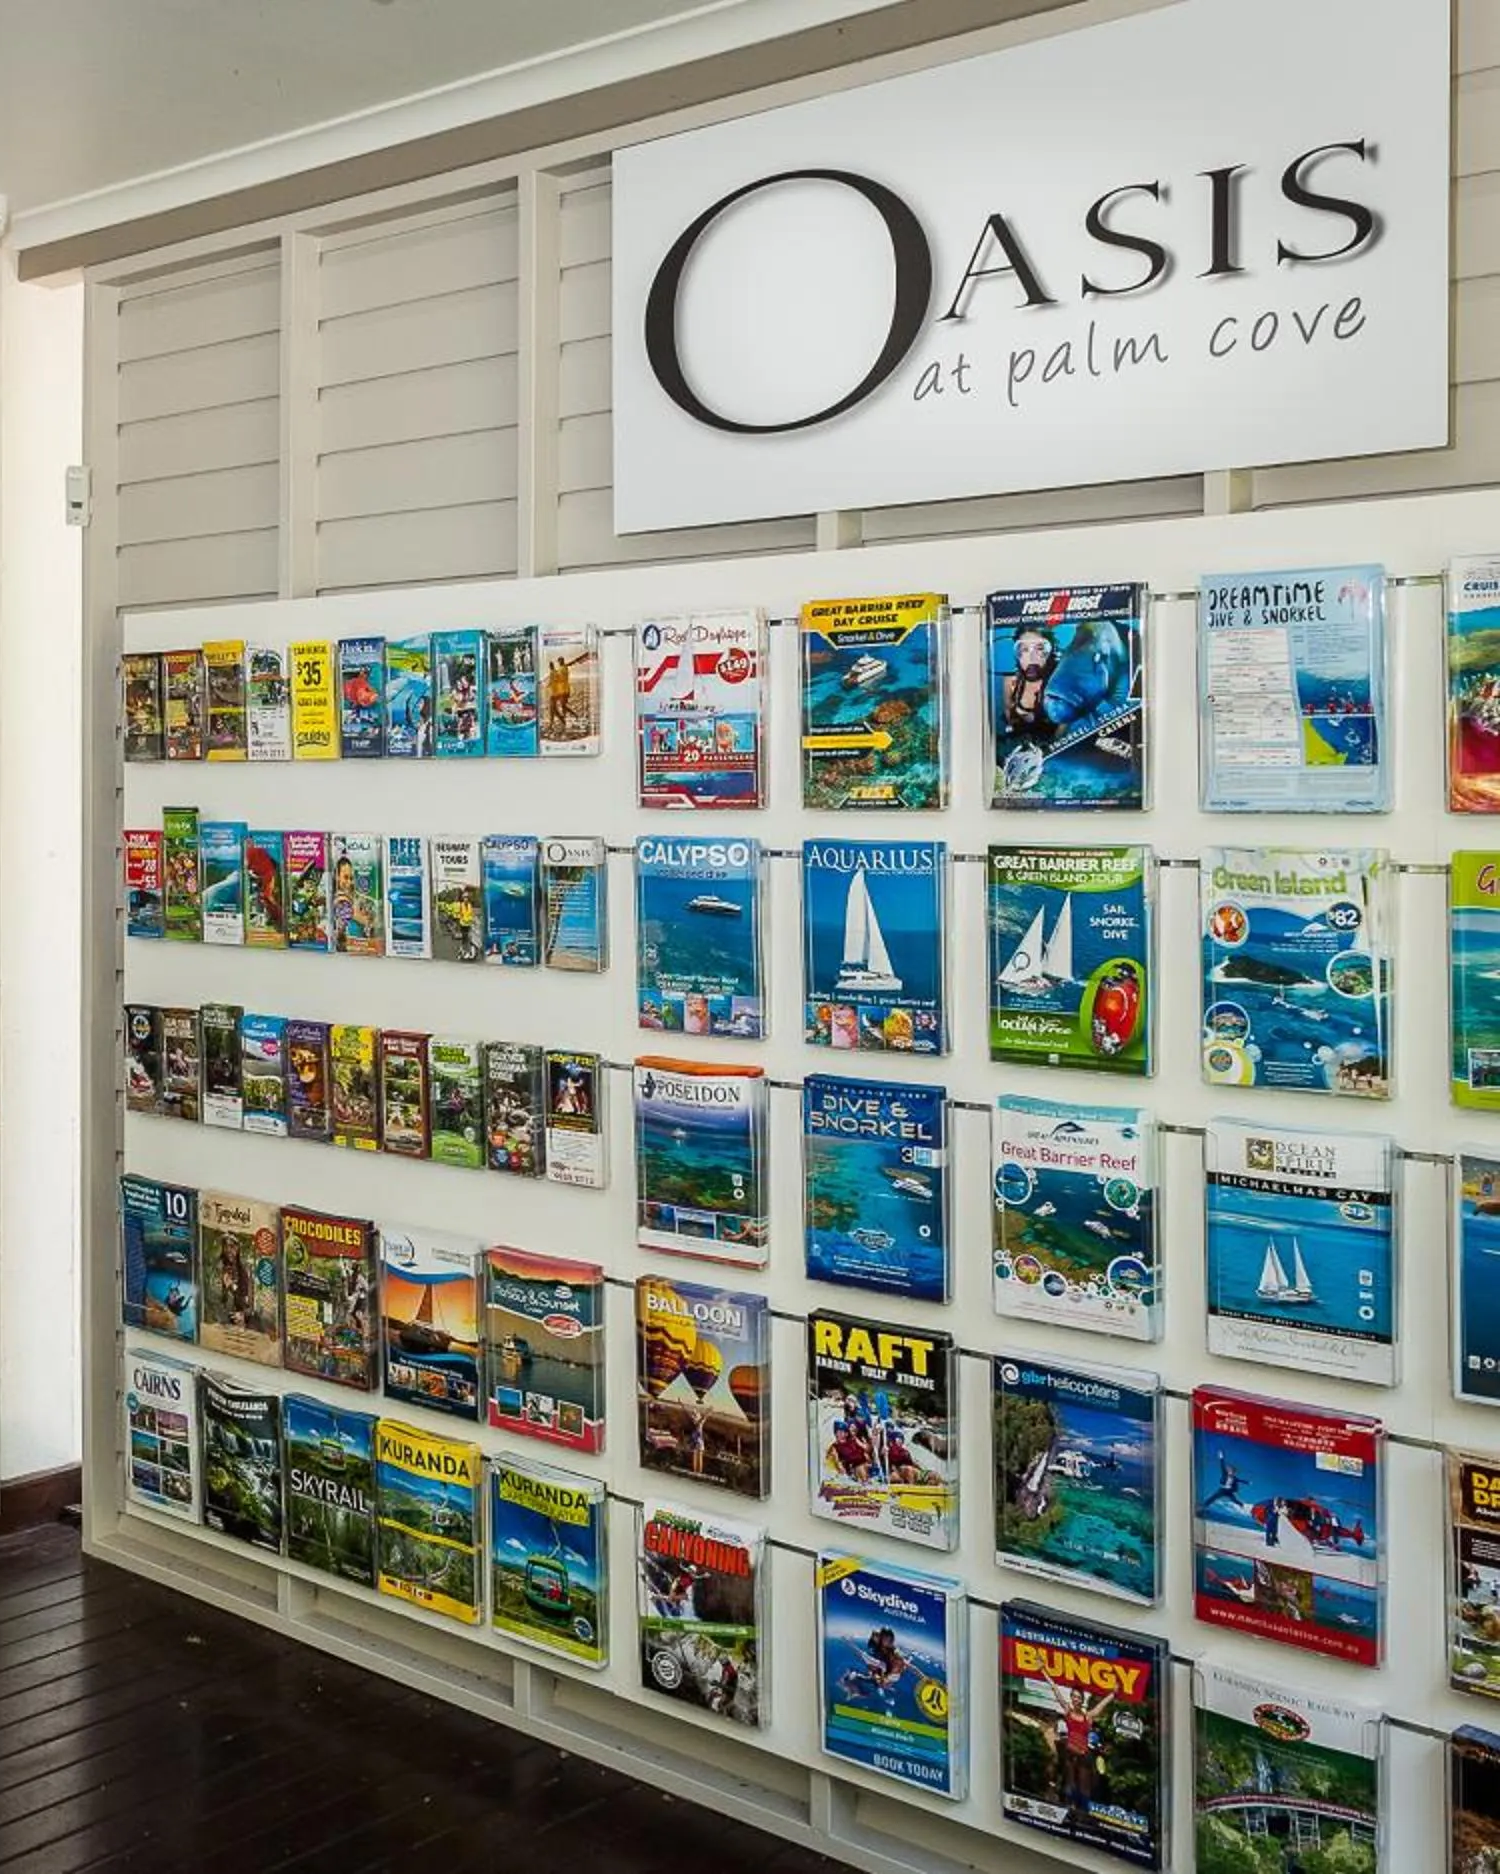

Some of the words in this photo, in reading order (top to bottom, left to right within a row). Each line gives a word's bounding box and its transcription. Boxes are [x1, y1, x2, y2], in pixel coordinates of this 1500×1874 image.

[645, 138, 1376, 434] OASIS
[913, 352, 971, 401] at
[1008, 321, 1169, 407] palm
[1210, 296, 1367, 358] cove
[812, 604, 842, 617] GREAT
[845, 601, 893, 615] BARRIER
[896, 599, 924, 611] REEF
[833, 617, 854, 628] DAY
[858, 613, 899, 626] CRUISE
[1243, 611, 1252, 626] &
[1262, 605, 1325, 625] SNORKEL
[837, 632, 868, 643] Snorkel
[876, 630, 895, 641] Dive
[297, 661, 322, 686] $35
[684, 750, 699, 763] 20
[484, 838, 529, 850] CALYPSO
[640, 841, 749, 867] CALYPSO
[440, 855, 469, 865] TOURS
[809, 845, 933, 873] AQUARIUS
[994, 856, 1038, 870] GREAT
[1039, 857, 1099, 872] BARRIER
[1102, 858, 1138, 873] REEF
[1006, 871, 1013, 880] &
[1015, 871, 1047, 882] GREEN
[1050, 872, 1089, 883] ISLAND
[1212, 865, 1271, 894] Green
[1274, 869, 1347, 895] Island
[1103, 904, 1127, 915] SAIL
[1103, 930, 1128, 940] DIVE
[656, 1079, 741, 1102] POSEIDON
[823, 1094, 881, 1116] DIVE
[891, 1101, 909, 1119] &
[810, 1111, 933, 1141] SNORKEL
[1001, 1141, 1038, 1162] Great
[1041, 1147, 1095, 1168] Barrier
[1100, 1153, 1137, 1171] Reef
[1221, 1175, 1328, 1198] MICHAELMAS
[1337, 1190, 1371, 1202] CAY
[165, 1191, 187, 1218] 10
[285, 1215, 361, 1246] CROCODILES
[538, 1291, 581, 1313] Sunset
[645, 1292, 742, 1327] BALLOON
[814, 1319, 935, 1376] RAFT
[133, 1367, 181, 1401] CAIRNS
[896, 1372, 936, 1391] XTREME
[382, 1437, 470, 1481] KURANDA
[291, 1468, 369, 1513] SKYRAIL
[501, 1469, 588, 1510] KURANDA
[644, 1520, 751, 1578] CANYONING
[857, 1583, 919, 1613] Skydive
[1015, 1629, 1076, 1651] AUSTRALIA'S
[1077, 1641, 1107, 1657] ONLY
[1015, 1641, 1141, 1696] BUNGY
[872, 1752, 904, 1773] BOOK
[907, 1760, 944, 1783] TODAY
